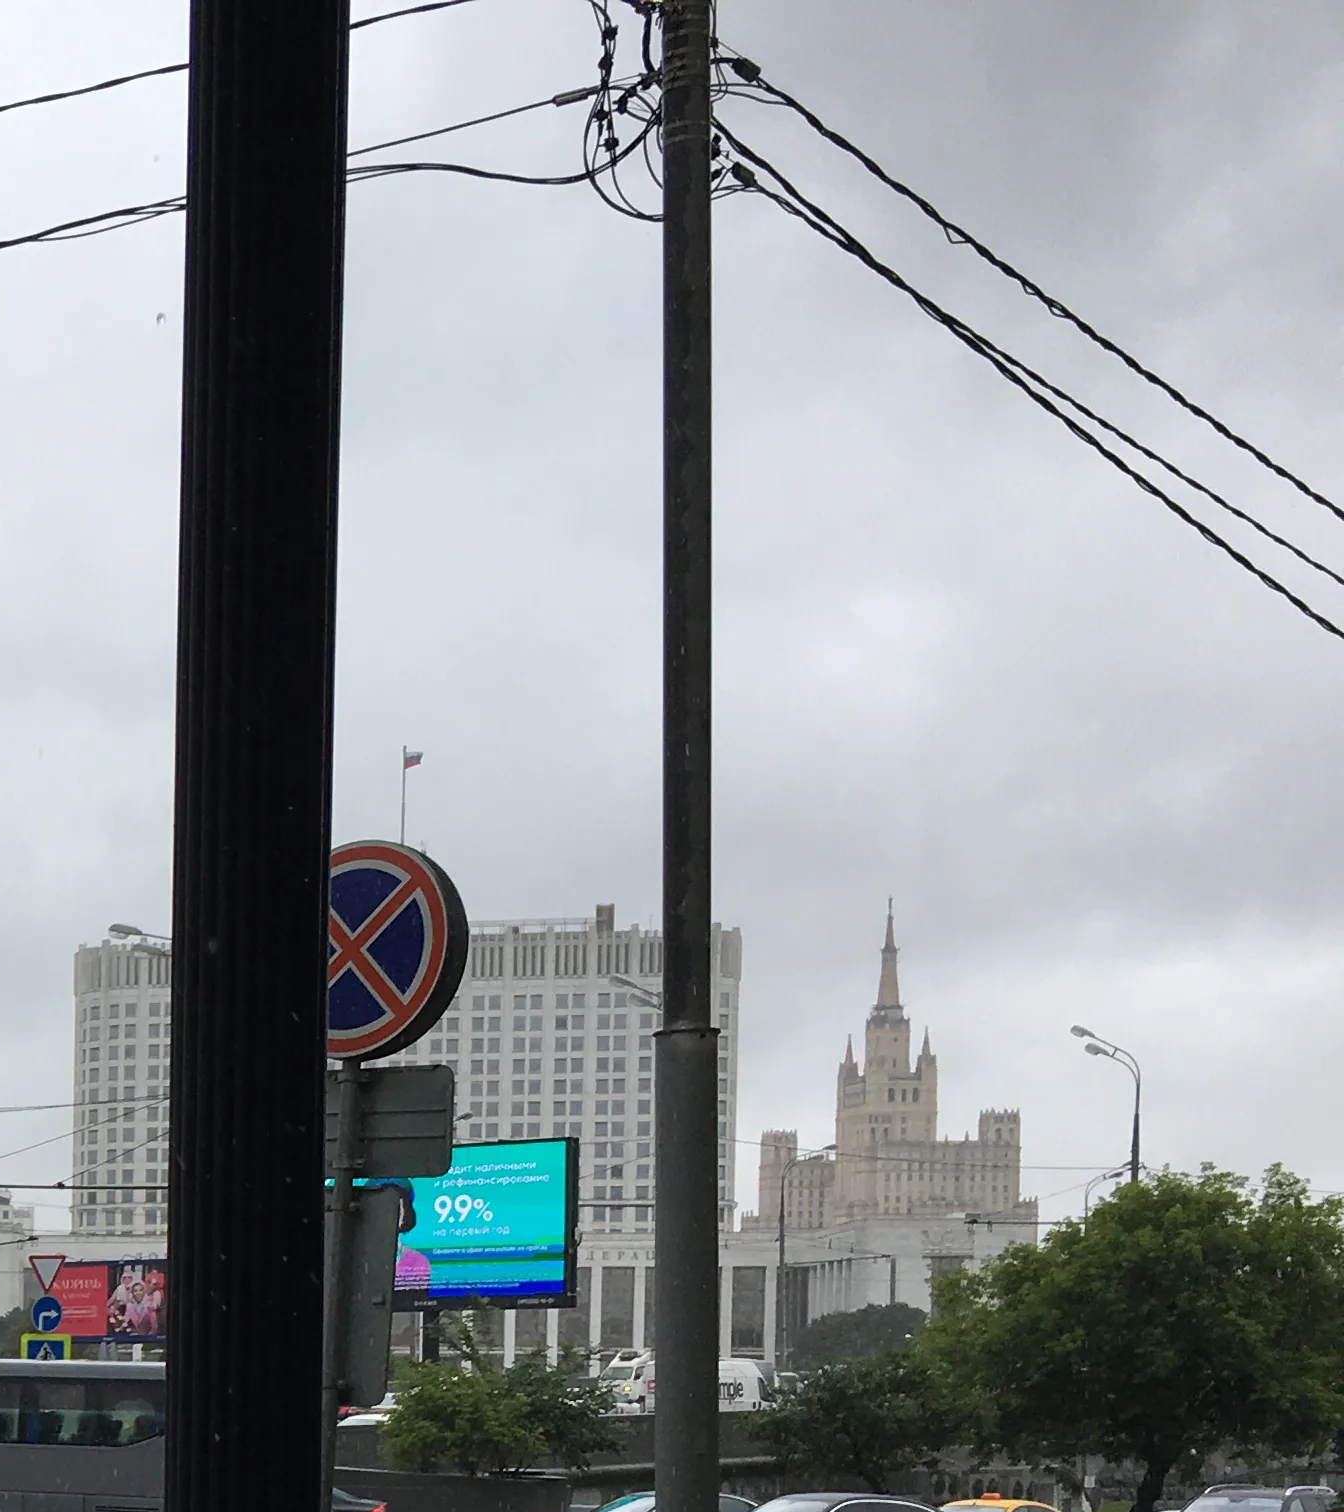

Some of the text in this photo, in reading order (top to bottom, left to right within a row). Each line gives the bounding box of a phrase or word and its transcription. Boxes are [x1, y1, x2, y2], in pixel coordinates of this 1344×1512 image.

[475, 1161, 537, 1173] наличными
[442, 1174, 550, 1189] рефинансирование
[434, 1194, 494, 1223] 9.9%
[433, 1226, 511, 1237] на первый год
